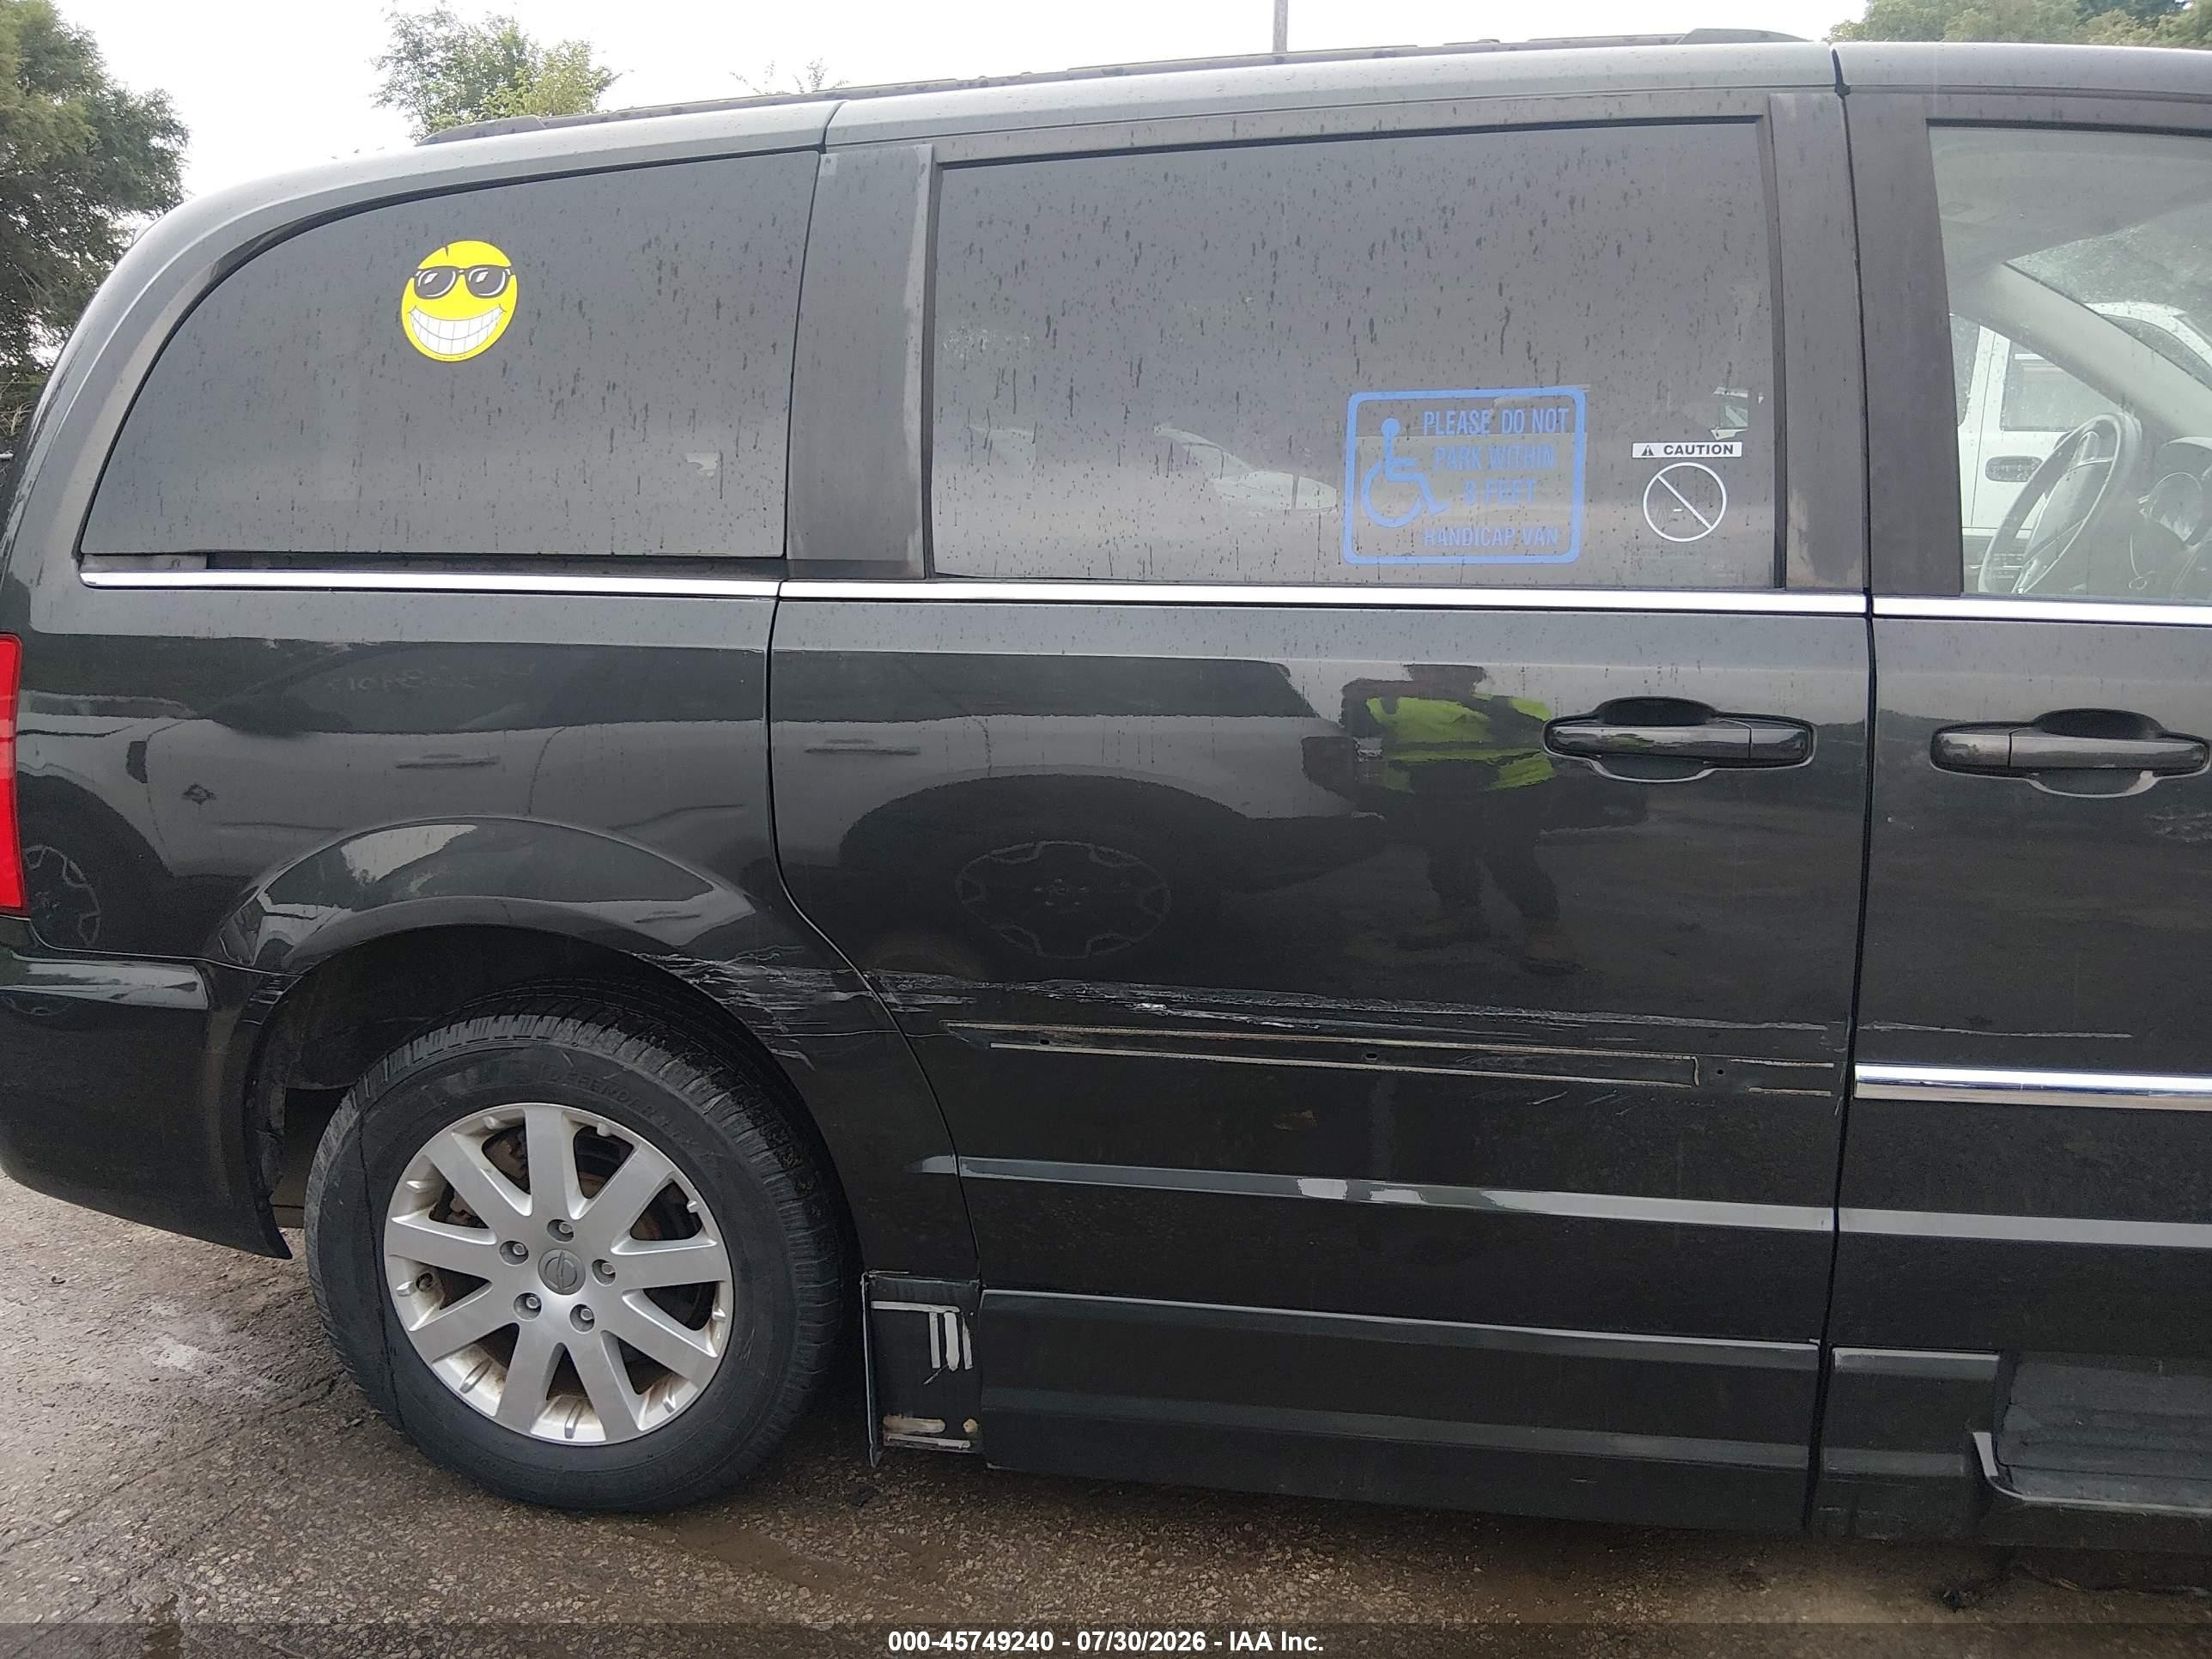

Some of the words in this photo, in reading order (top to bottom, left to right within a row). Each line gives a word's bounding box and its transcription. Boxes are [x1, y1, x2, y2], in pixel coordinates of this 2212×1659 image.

[1423, 409, 1492, 436] PLEASE
[1502, 408, 1525, 434] DO
[1531, 407, 1570, 434] NOT
[1434, 446, 1483, 471] PARK
[1489, 444, 1556, 470] WITHIN
[1663, 444, 1734, 455] CAUTION
[1484, 478, 1538, 507] FEET
[1423, 526, 1516, 547] HANDICAP
[1521, 526, 1559, 547] VAN
